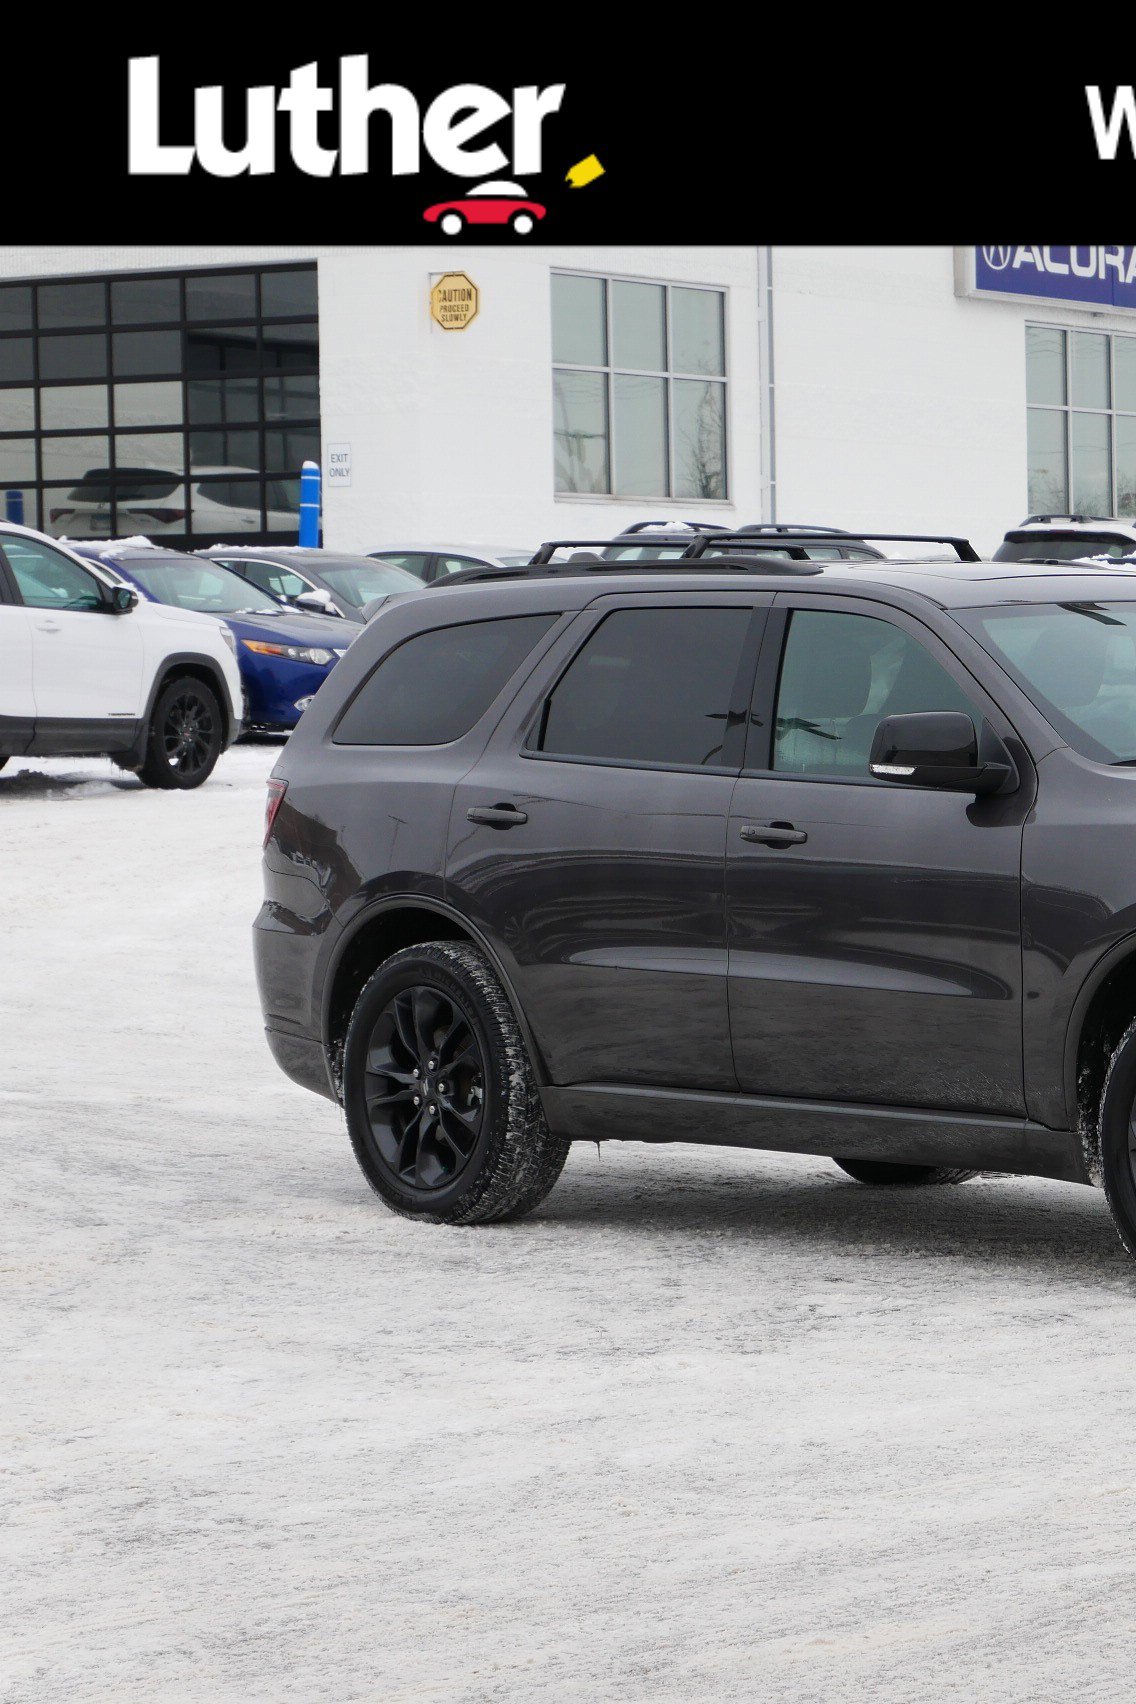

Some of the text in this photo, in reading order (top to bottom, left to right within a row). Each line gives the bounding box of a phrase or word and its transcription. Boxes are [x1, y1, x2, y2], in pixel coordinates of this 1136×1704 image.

[440, 304, 469, 312] PROCEED
[440, 313, 467, 322] SLOWLY
[330, 453, 348, 463] EXIT
[329, 467, 350, 477] ONLY
